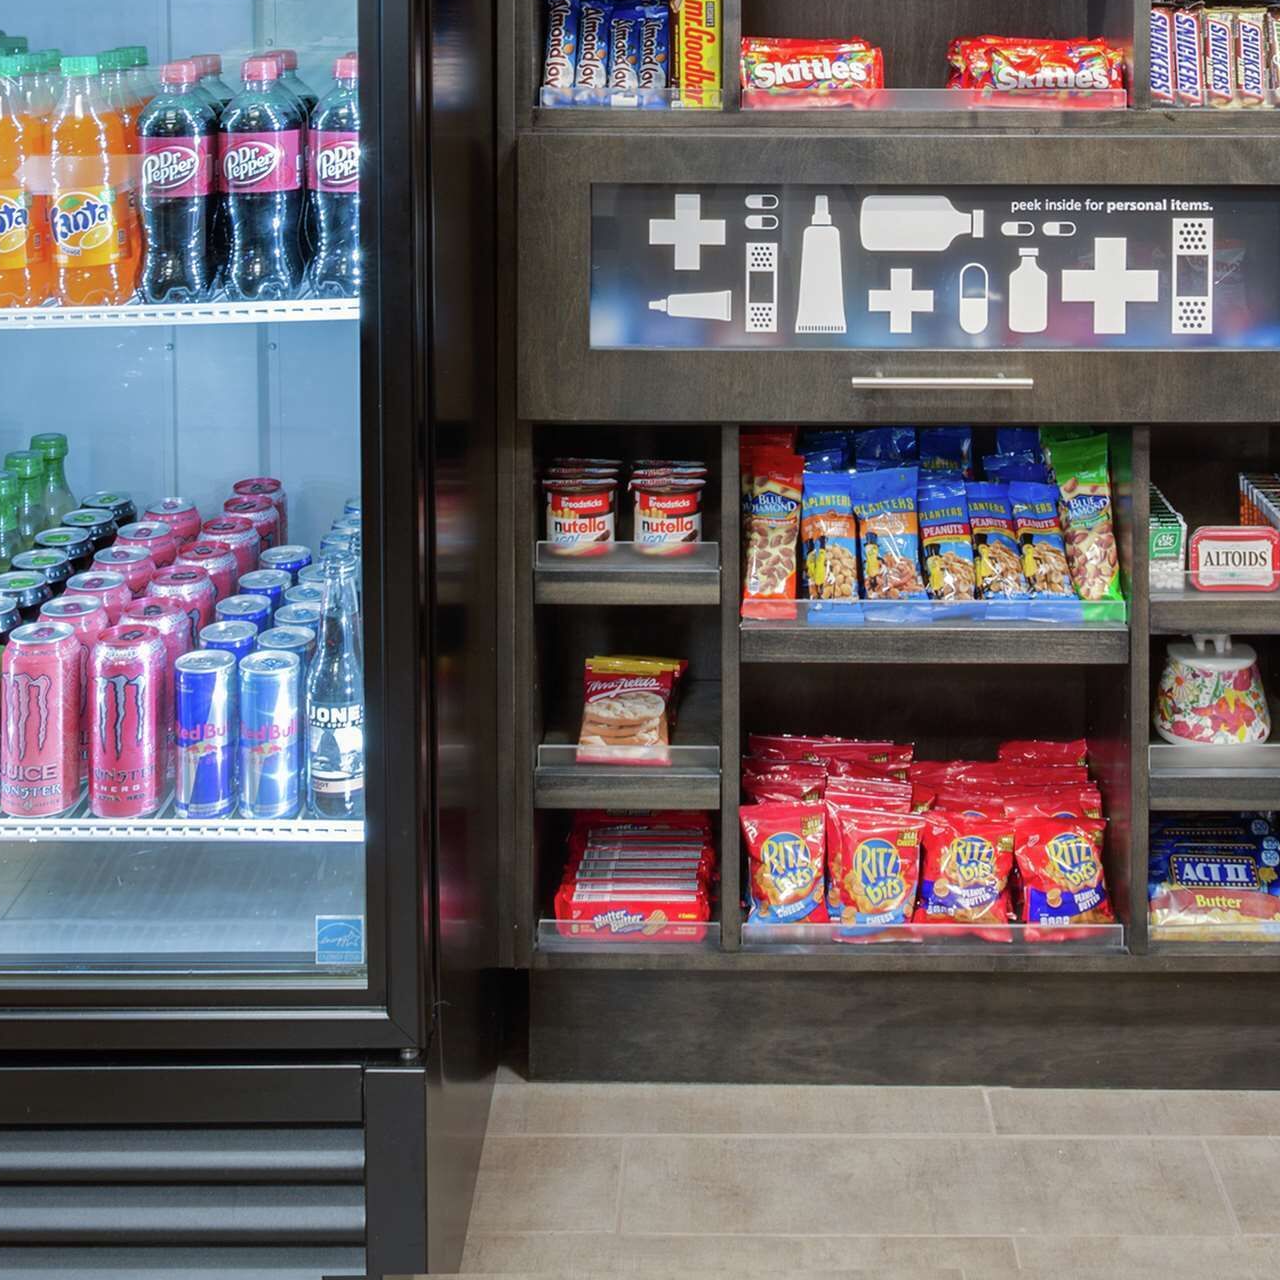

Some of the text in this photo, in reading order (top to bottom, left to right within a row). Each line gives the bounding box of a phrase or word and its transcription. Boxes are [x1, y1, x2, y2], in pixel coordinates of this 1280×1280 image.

[545, 0, 571, 88] Almond Joy
[579, 5, 604, 88] Almond Joy
[613, 19, 634, 88] Almond Joy
[640, 18, 662, 88] Almond Joy
[1150, 11, 1170, 96] SNICKERS
[1176, 14, 1198, 97] SNICKERS
[1211, 23, 1231, 95] SNICKERS
[1242, 24, 1262, 95] SNICKERS
[754, 56, 867, 89] Skittles
[997, 65, 1111, 91] Skittles
[159, 146, 180, 166] Dr
[240, 145, 261, 164] Dr
[146, 157, 196, 184] Pepper
[226, 153, 274, 181] Pepper
[1011, 198, 1214, 214] peek inside for personal items.
[758, 495, 784, 505] BLUE
[853, 496, 915, 516] PLANTERS
[920, 507, 963, 520] PLANTERS
[970, 517, 1008, 529] PEANUTS
[1017, 518, 1056, 529] PEANUTS
[554, 517, 607, 534] nutella
[642, 517, 695, 534] nutella
[923, 525, 964, 537] PEANUTS
[1161, 531, 1175, 542] tic
[1203, 550, 1268, 568] ALTOIDS
[1, 763, 59, 782] JUICE
[764, 840, 810, 874] RITZ
[953, 839, 994, 865] RITZ
[1047, 839, 1093, 869] RITZ
[856, 845, 898, 883] RITZ
[1182, 862, 1250, 882] ACT II
[961, 888, 986, 899] PEANUT
[1074, 889, 1095, 903] PEANUT
[1196, 893, 1242, 910] Butter
[1078, 895, 1100, 913] BUTTER
[593, 909, 627, 929] Nutter
